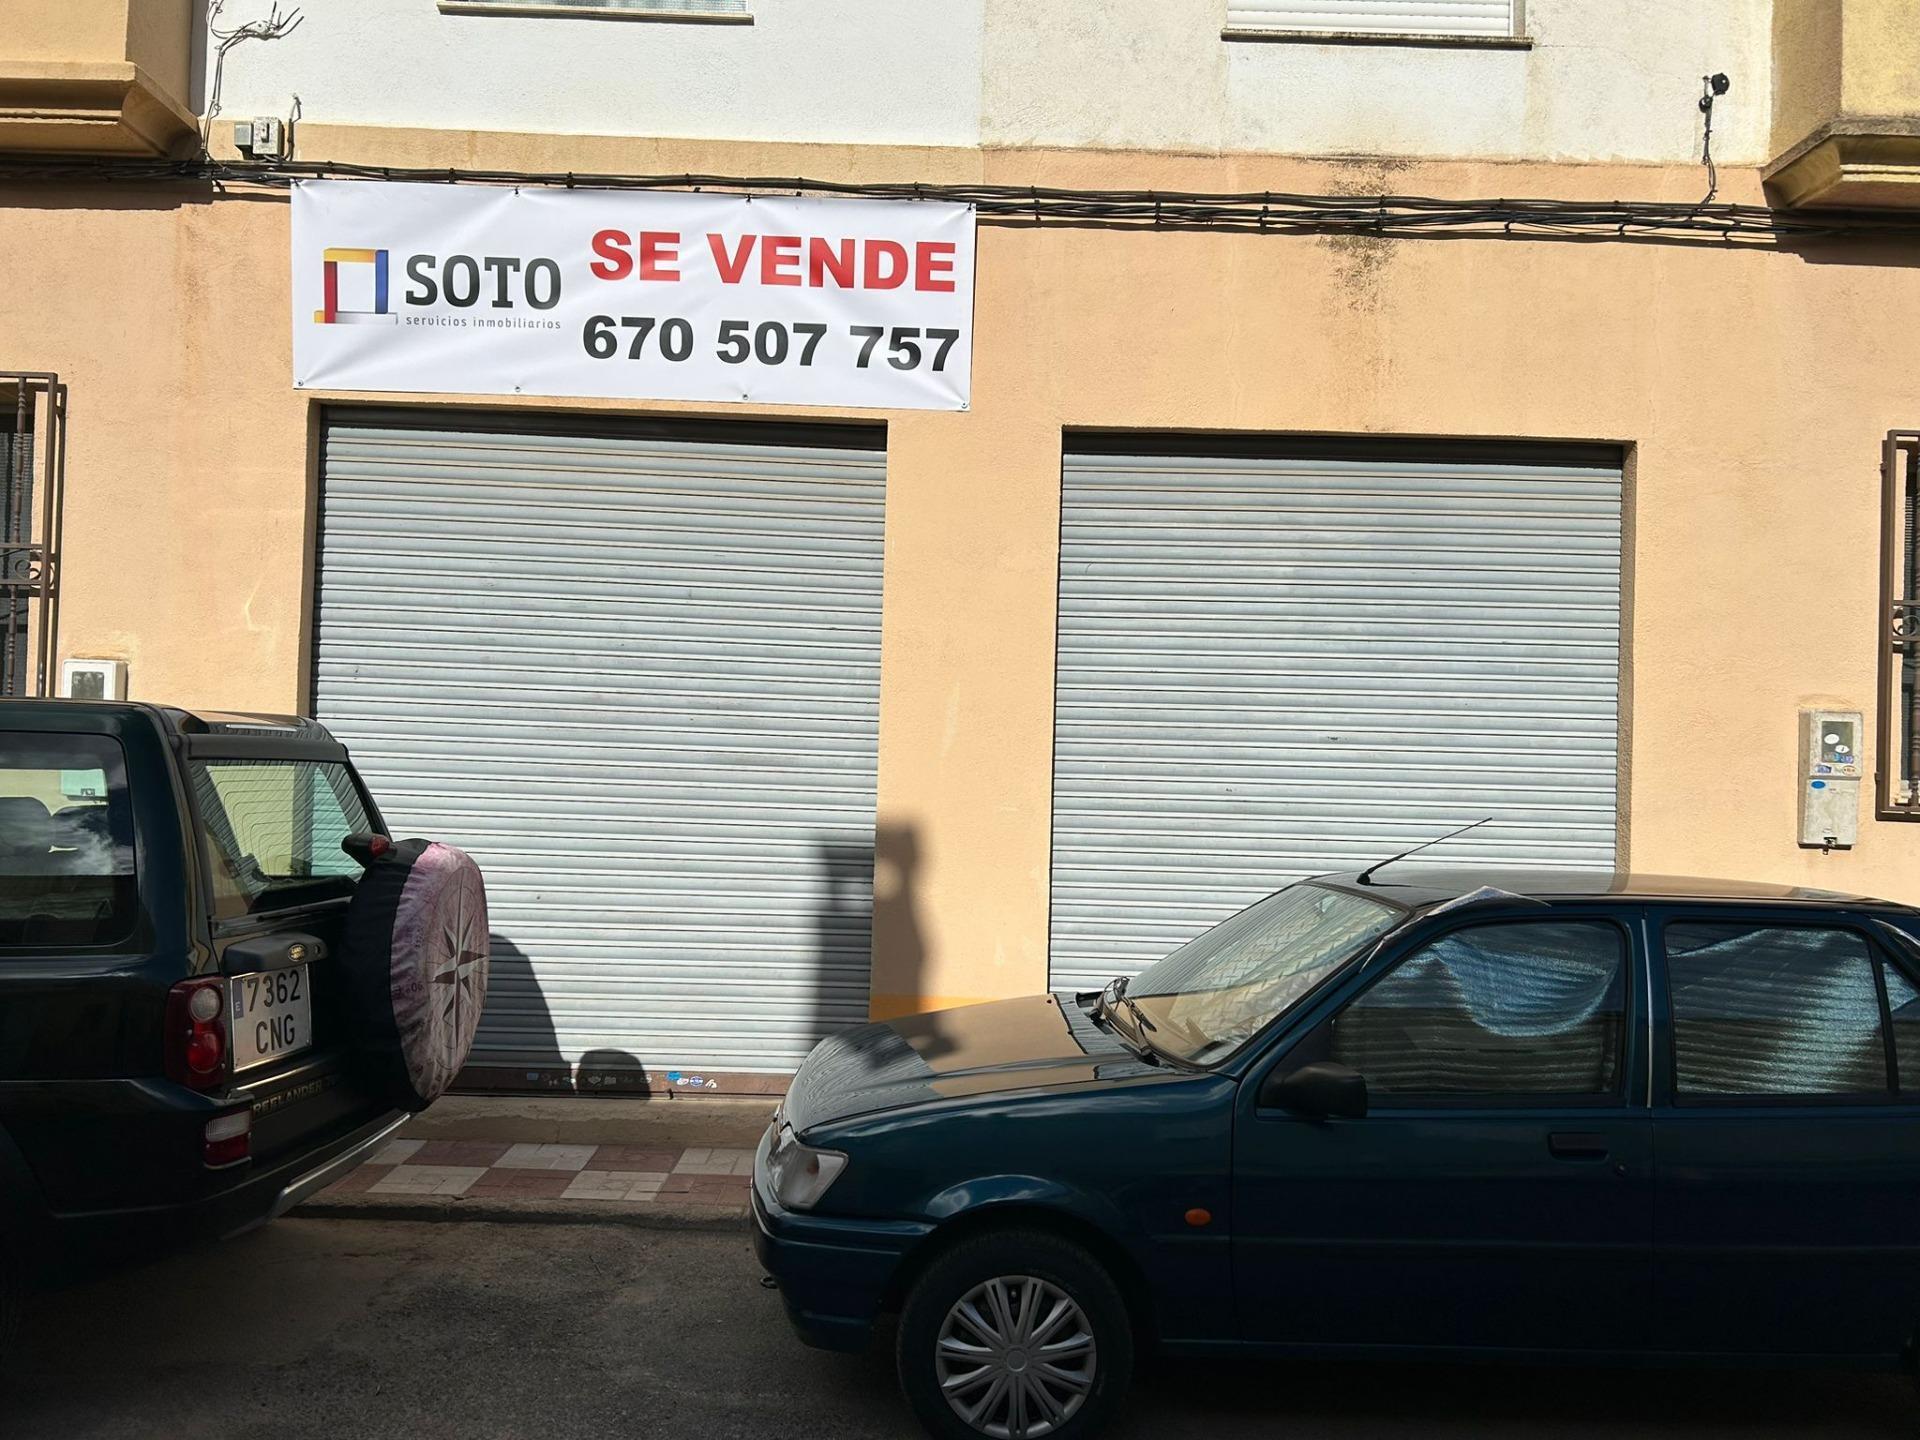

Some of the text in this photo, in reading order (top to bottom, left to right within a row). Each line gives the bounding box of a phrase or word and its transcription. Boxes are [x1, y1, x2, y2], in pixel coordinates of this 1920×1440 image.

[405, 254, 562, 310] SOTO
[590, 229, 956, 293] SE VENDE
[405, 315, 561, 329] servicios inmobiliarios
[583, 315, 960, 372] 670 507 757
[247, 969, 301, 1013] 7362
[255, 1014, 296, 1054] CNG
